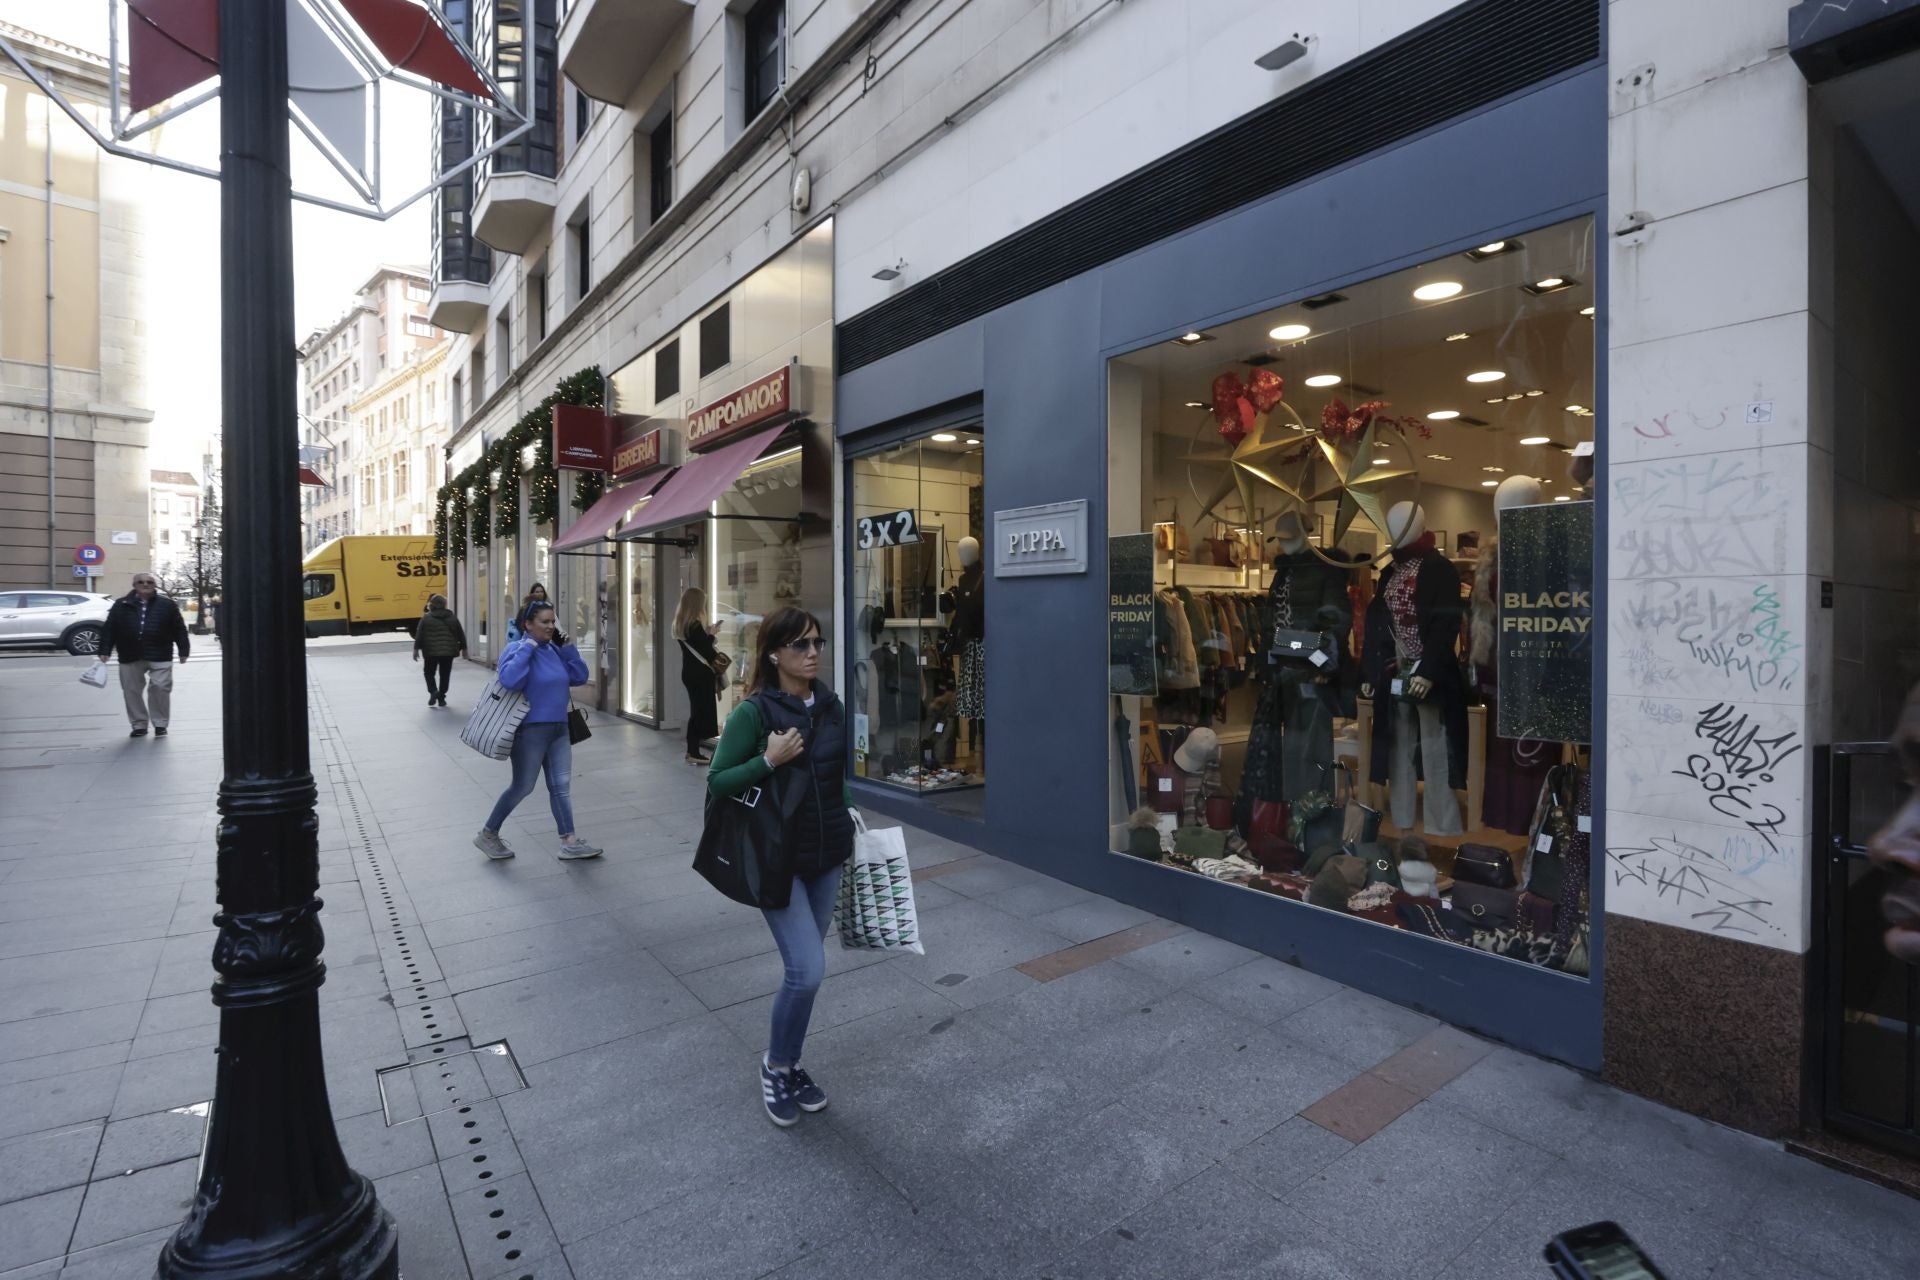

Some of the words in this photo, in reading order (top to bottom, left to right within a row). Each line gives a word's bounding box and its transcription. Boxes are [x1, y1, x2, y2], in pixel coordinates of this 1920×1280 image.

[688, 377, 783, 441] CAMPOAMOR
[1008, 528, 1066, 554] PIPPA
[1111, 593, 1152, 606] BLACK
[1504, 591, 1591, 609] BLACK
[1110, 610, 1153, 622] FRIDAY
[1503, 616, 1592, 633] FRIDAY
